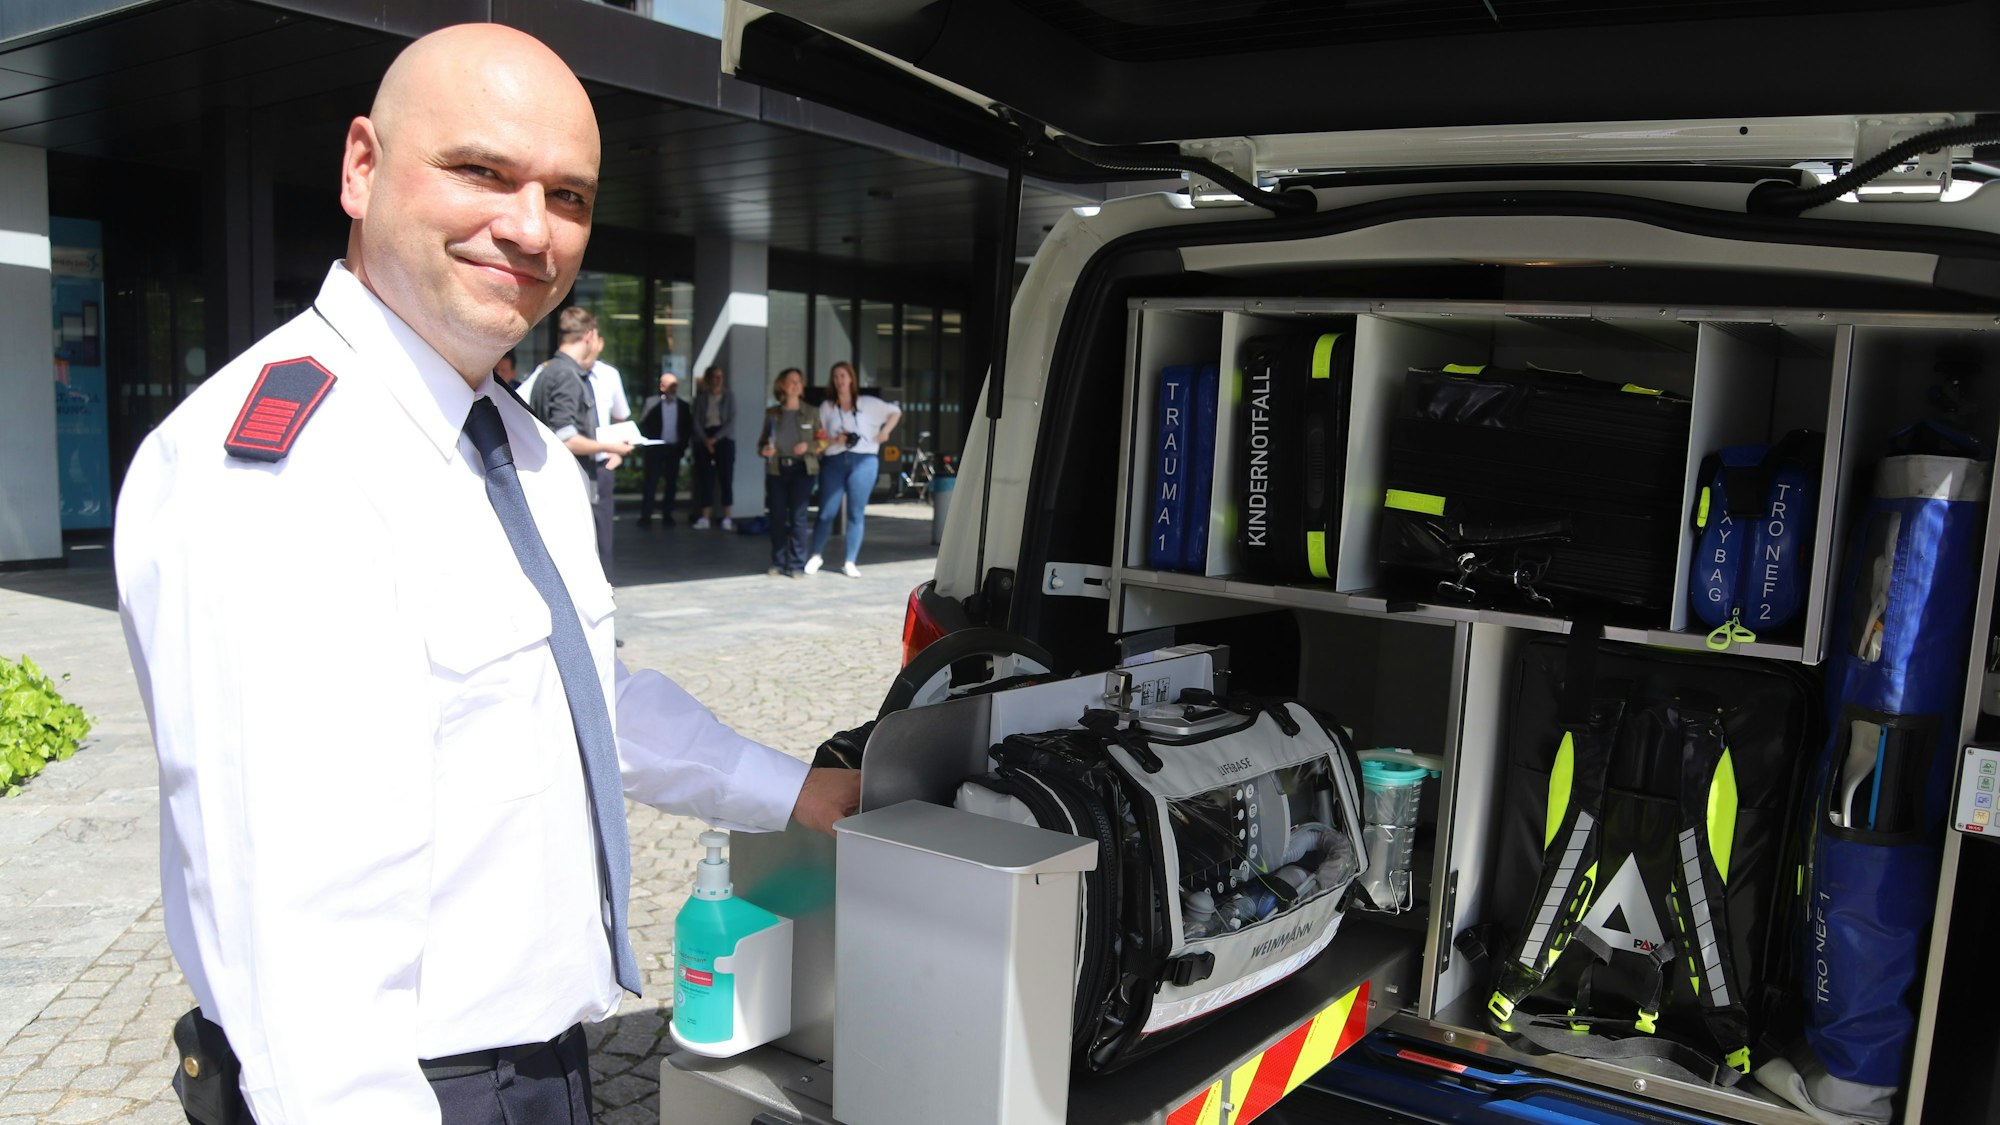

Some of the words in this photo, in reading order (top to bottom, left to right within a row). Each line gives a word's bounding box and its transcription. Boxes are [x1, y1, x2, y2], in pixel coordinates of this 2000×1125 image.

[1157, 382, 1180, 525] TRAUMA
[1248, 367, 1271, 546] KINDERNOTFALL
[1768, 484, 1790, 537] TRO
[1158, 535, 1165, 551] 1
[1708, 507, 1733, 602] XYBAG
[1762, 545, 1781, 598] NEF
[1759, 604, 1771, 620] 2
[1819, 891, 1830, 900] 1
[1251, 920, 1314, 959] WEINMANN
[1815, 907, 1827, 952] NEF
[1816, 959, 1830, 1003] TRO
